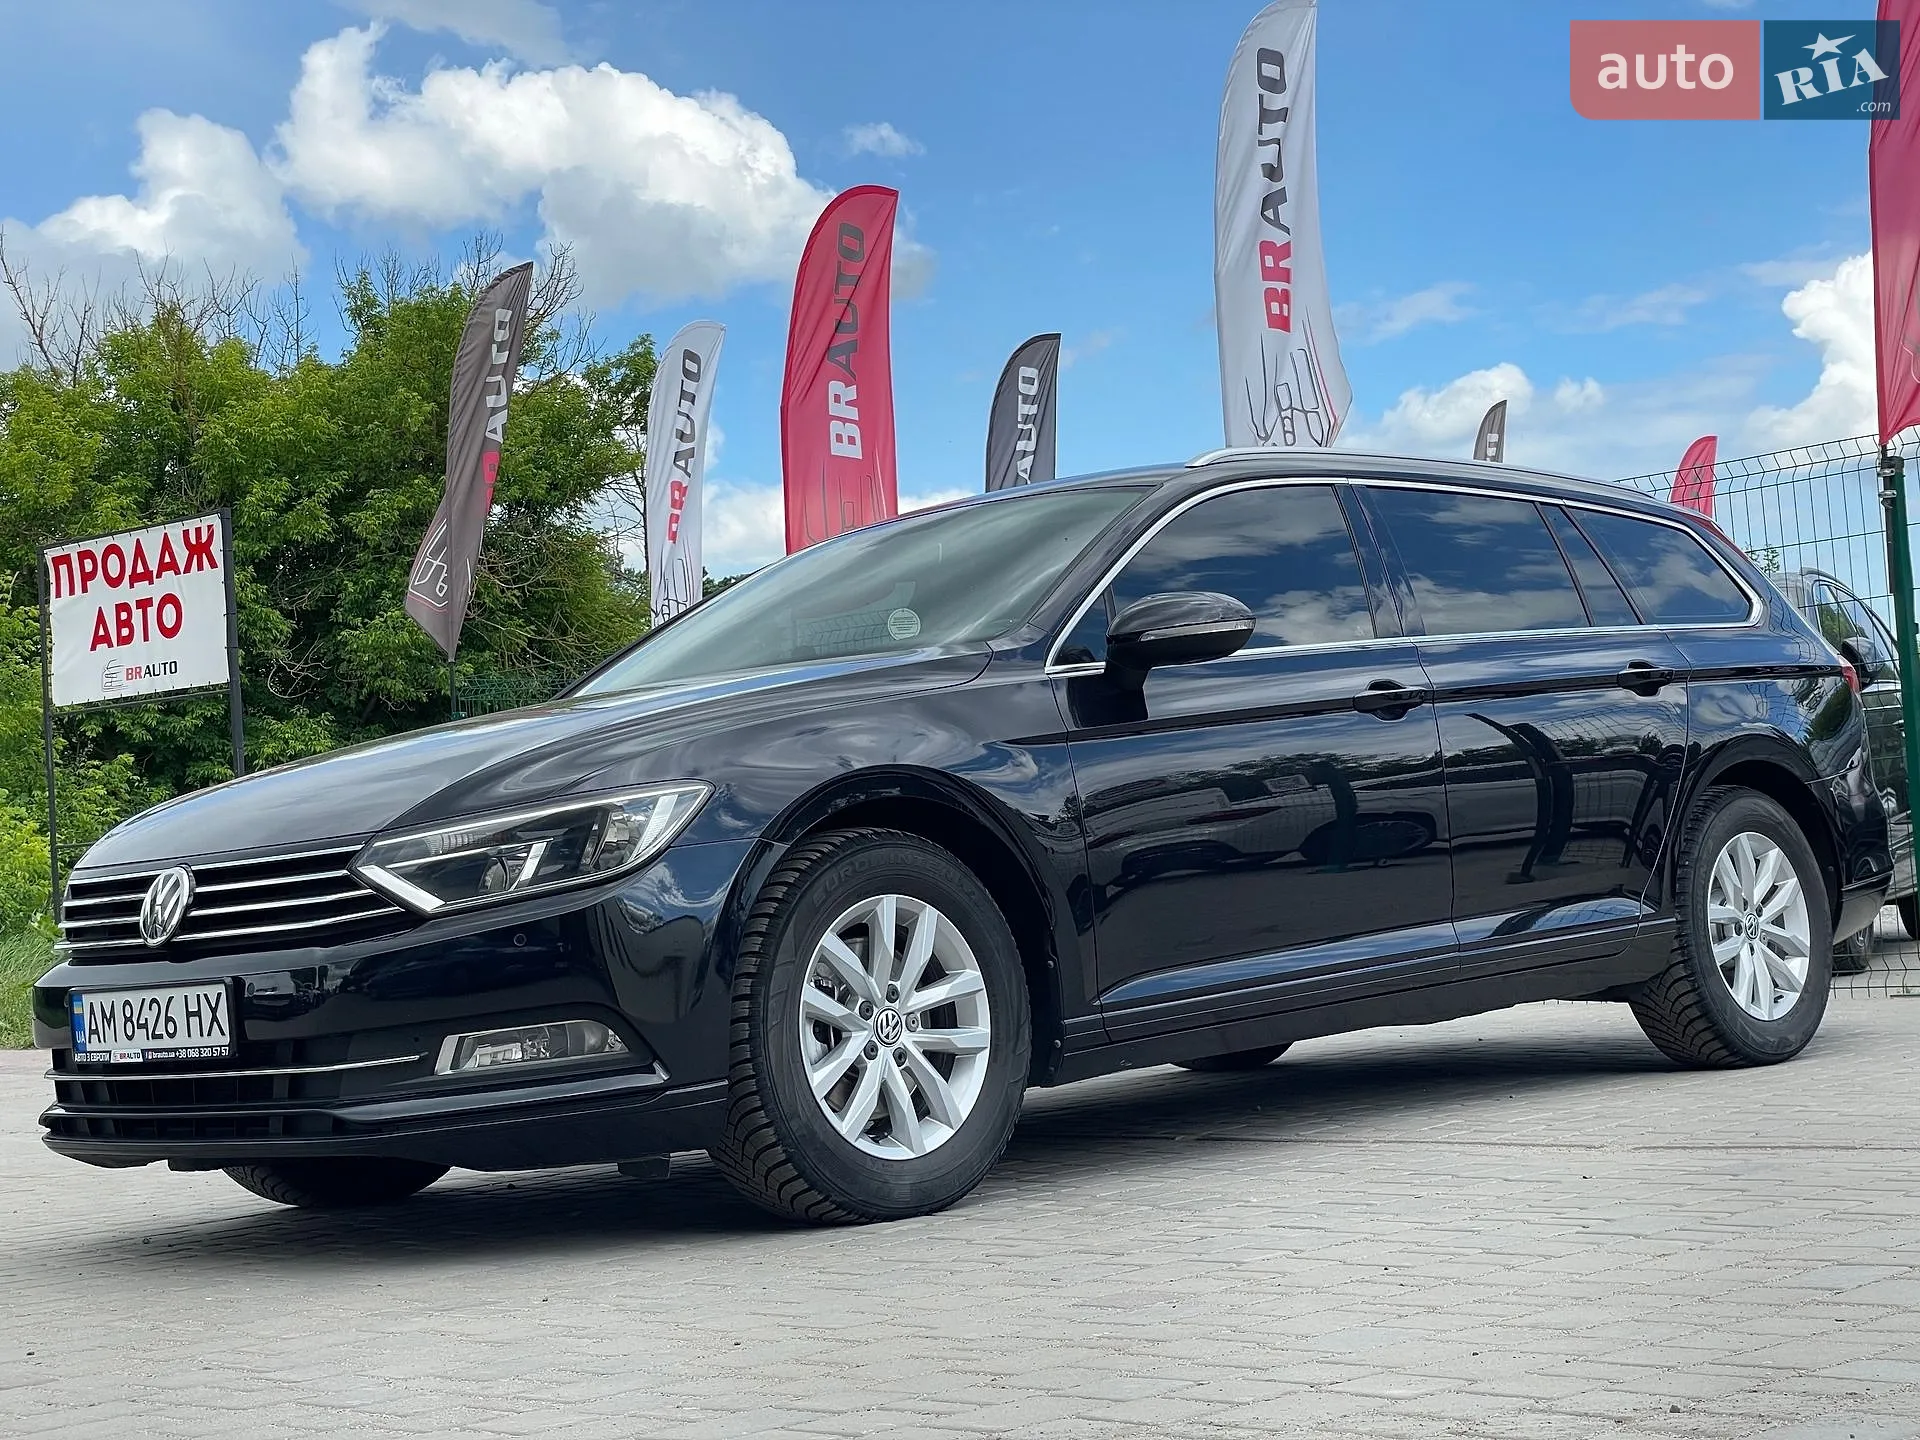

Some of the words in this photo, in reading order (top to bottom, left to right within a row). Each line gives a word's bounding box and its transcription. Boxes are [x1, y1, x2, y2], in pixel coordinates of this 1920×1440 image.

[1256, 46, 1293, 334] BRAUTO
[827, 222, 865, 460] BRAUTO
[482, 308, 513, 513] RAUTO
[51, 524, 218, 599] ПРОДАЖ
[89, 593, 183, 652] АВТО
[125, 660, 178, 681] BRAUTO
[76, 1031, 86, 1043] UA
[88, 1001, 118, 1043] AM
[122, 996, 178, 1041] 8426
[184, 992, 226, 1037] HX
[119, 1052, 141, 1060] BRAUTO
[176, 1050, 187, 1059] +38
[187, 1049, 200, 1058] 068
[200, 1048, 212, 1057] 320
[212, 1047, 221, 1056] 57
[221, 1046, 229, 1056] 57
